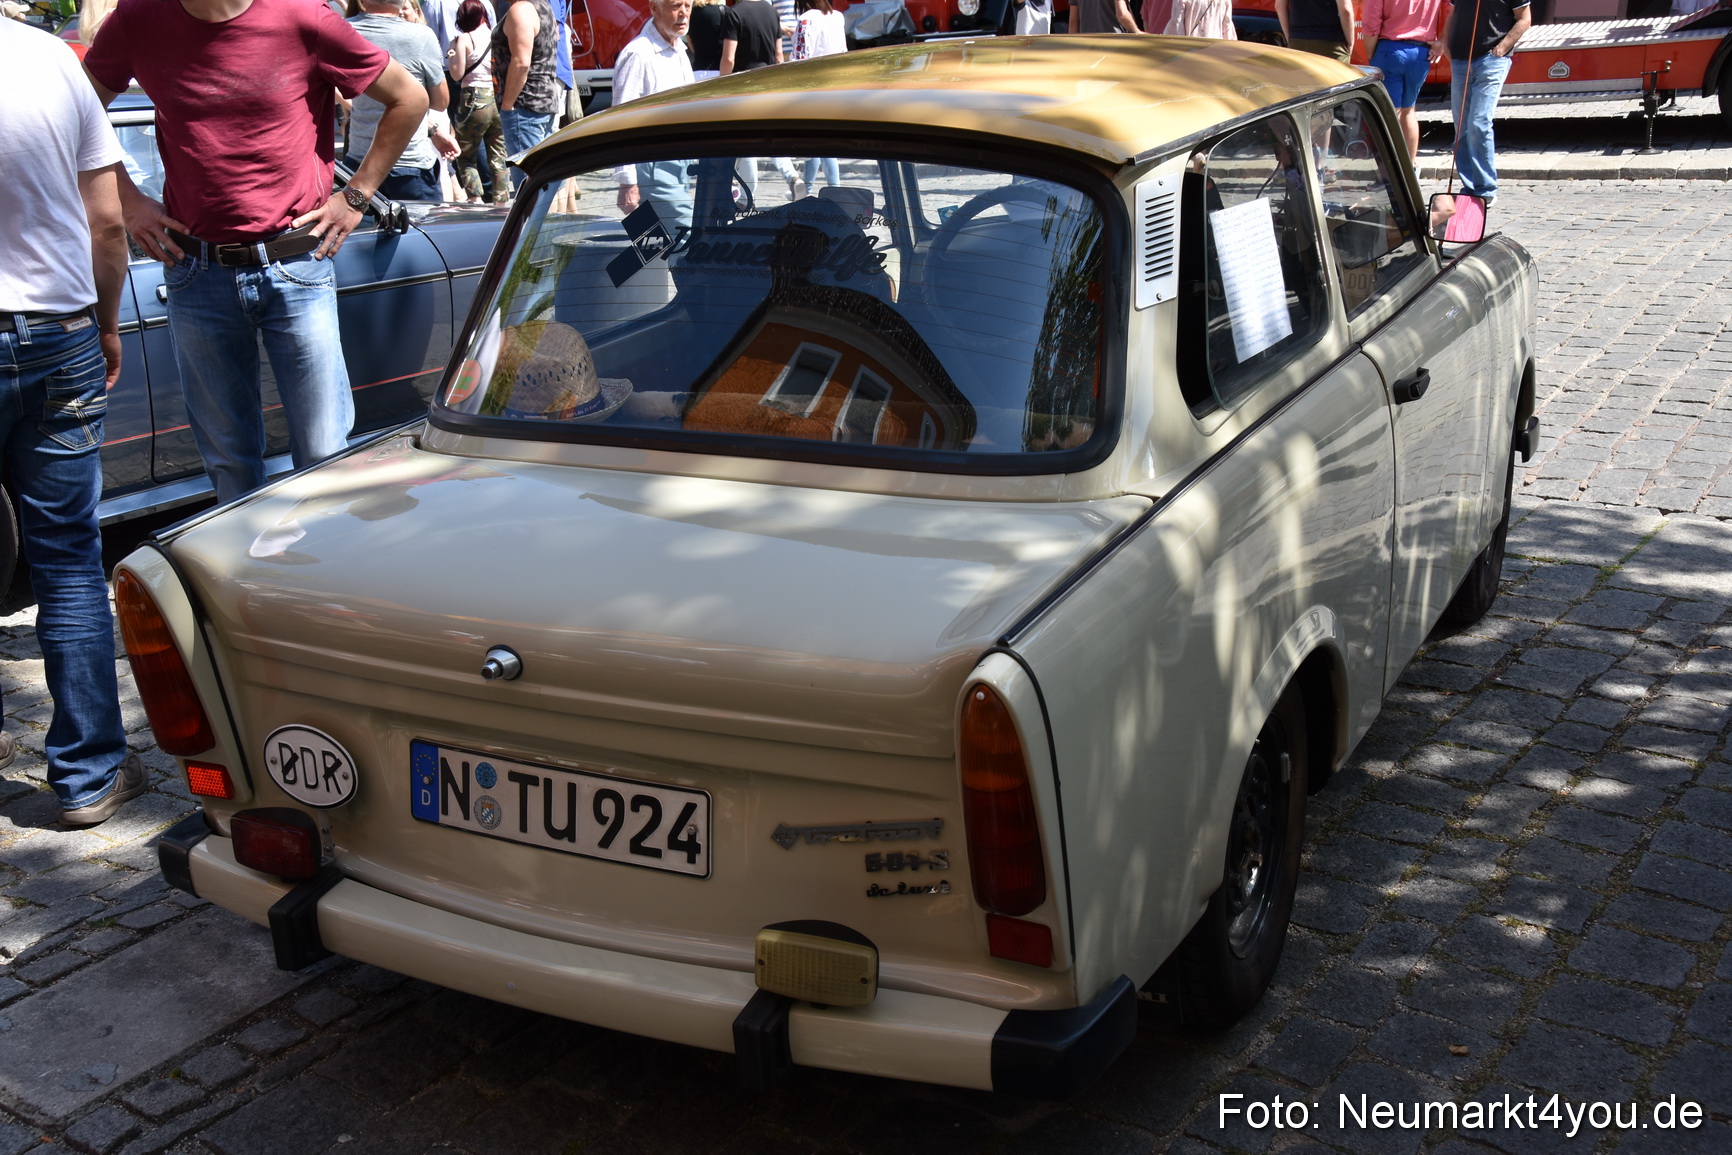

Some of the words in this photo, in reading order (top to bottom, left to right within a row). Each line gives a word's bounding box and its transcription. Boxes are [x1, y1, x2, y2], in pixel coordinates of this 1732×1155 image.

[853, 213, 898, 228] Barkas
[640, 236, 664, 250] IFA
[278, 741, 343, 796] DDR
[422, 788, 431, 806] D
[440, 757, 470, 821] N
[508, 770, 577, 843] TU
[593, 788, 702, 864] 924
